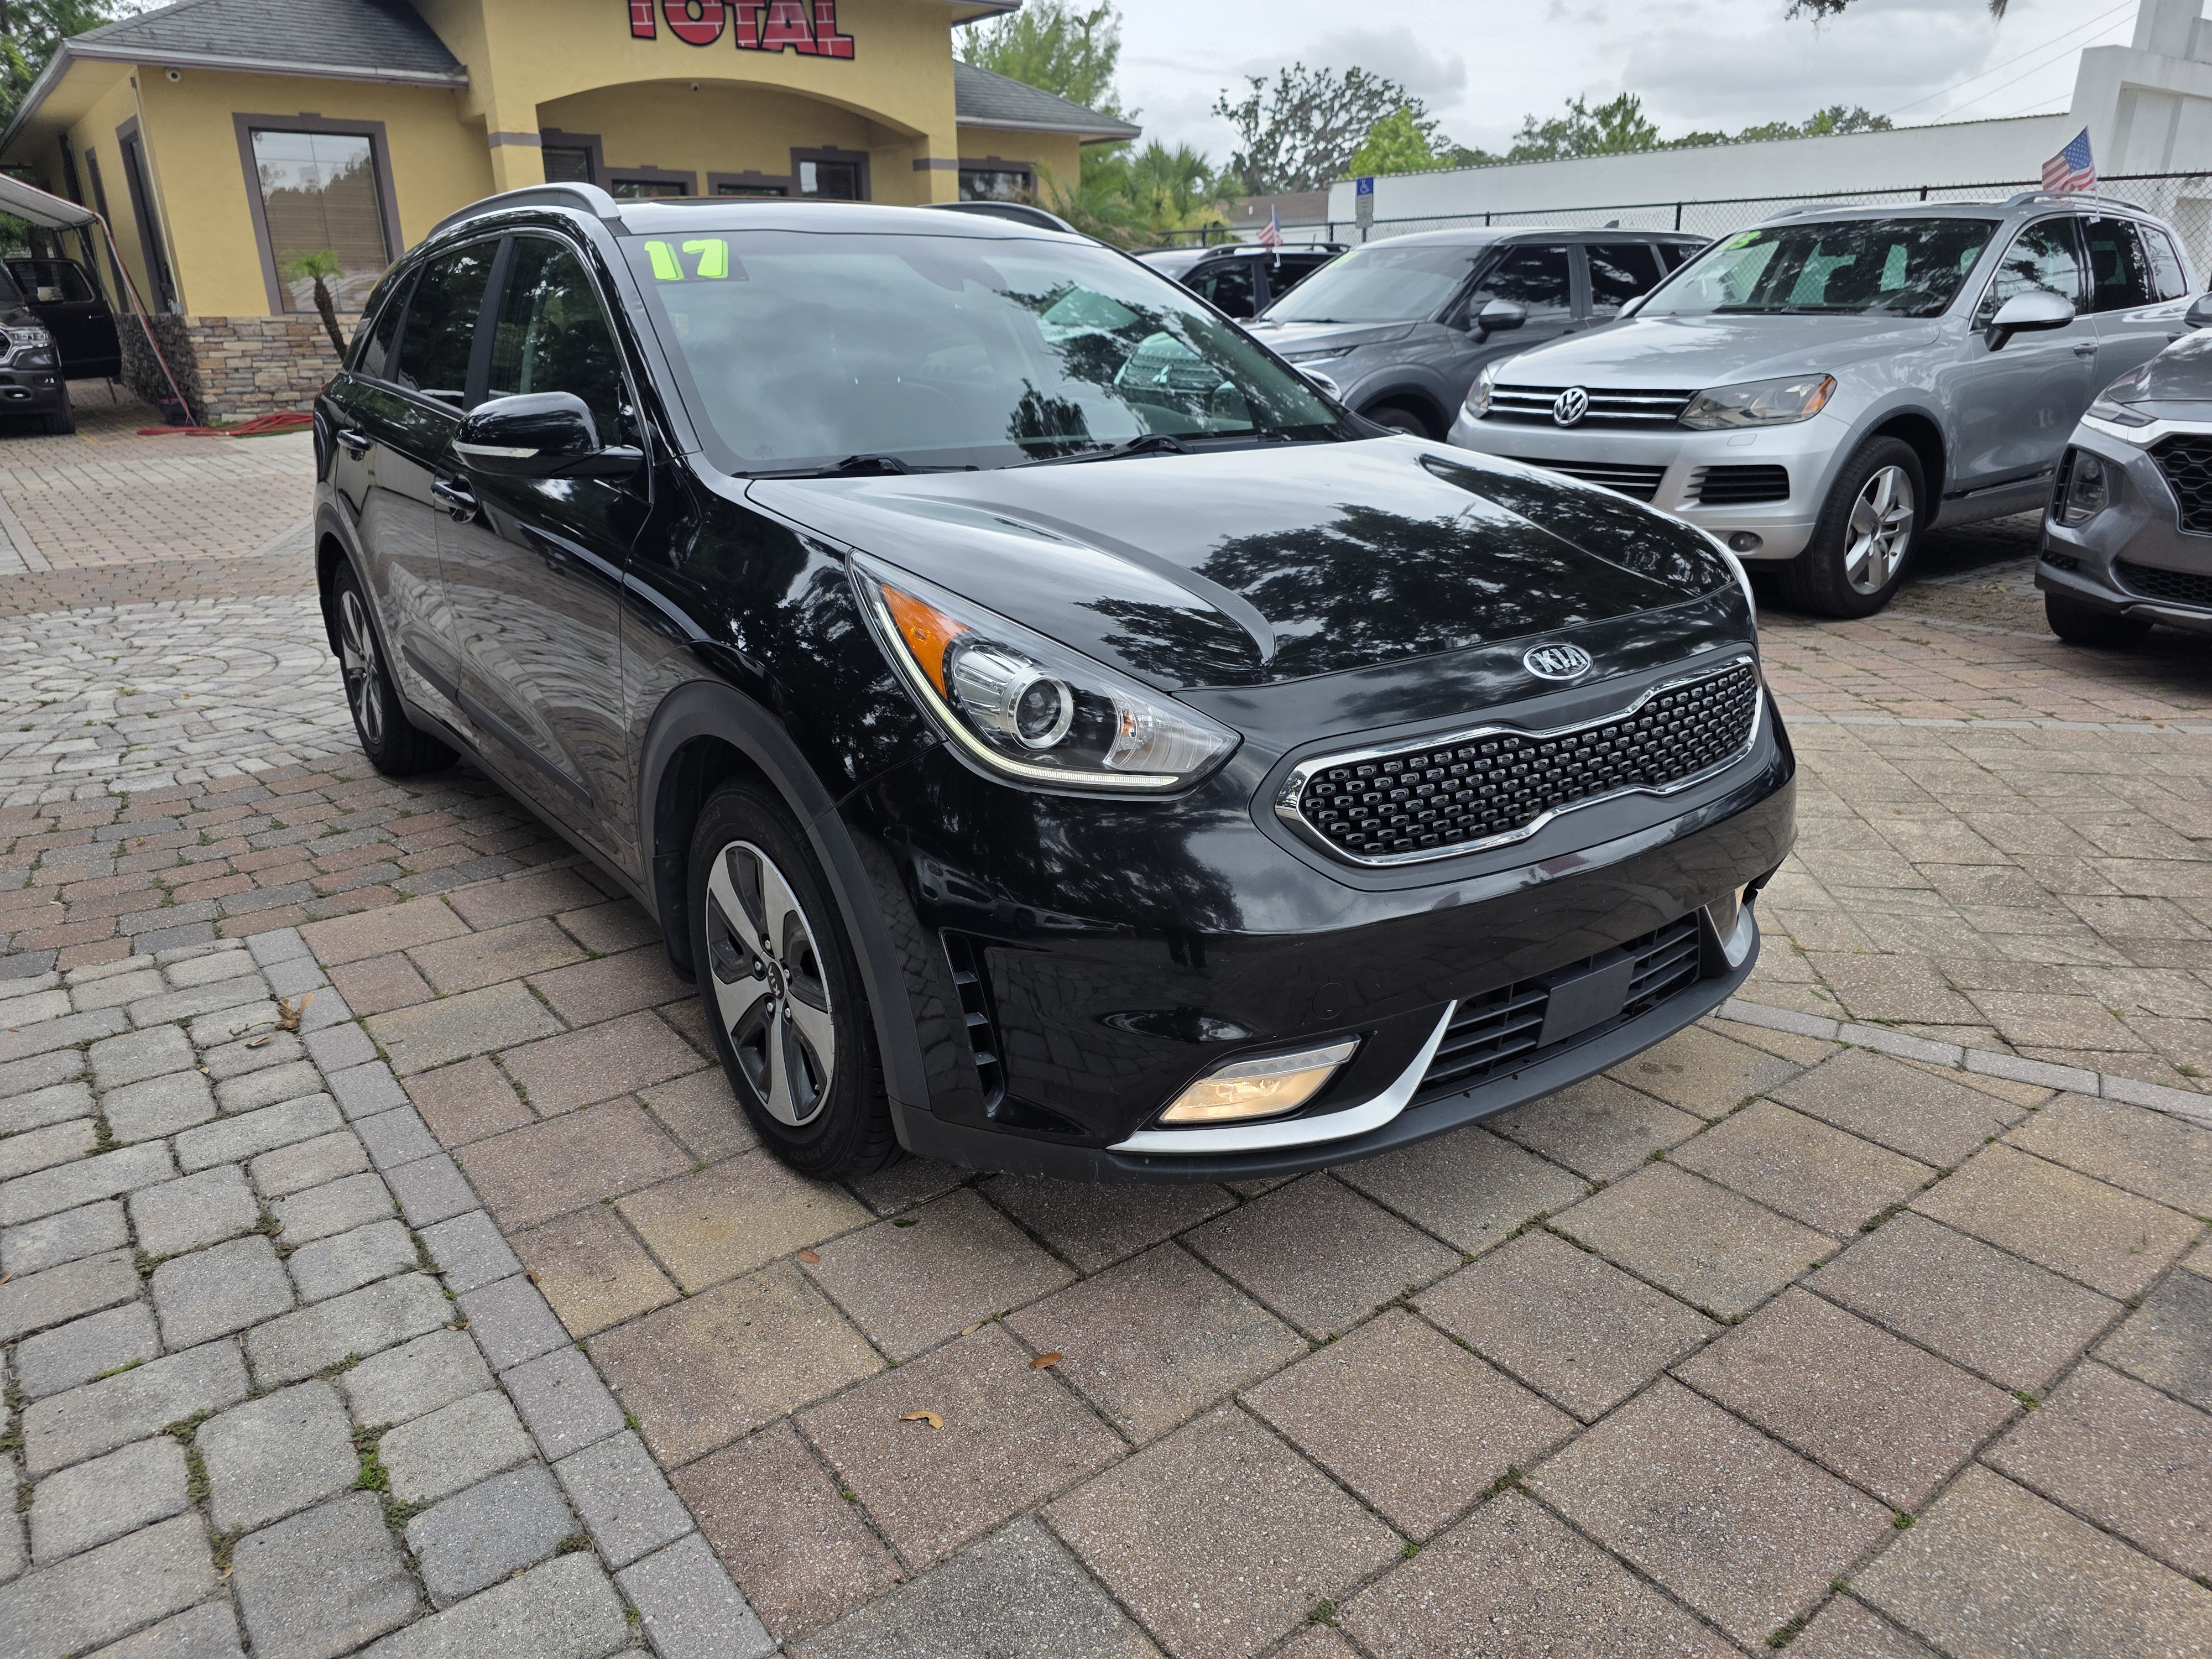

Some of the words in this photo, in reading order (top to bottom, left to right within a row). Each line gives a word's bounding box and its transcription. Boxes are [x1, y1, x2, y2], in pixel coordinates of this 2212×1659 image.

[644, 239, 728, 280] 17
[1532, 646, 1588, 673] KIA
[768, 965, 781, 996] KIA
